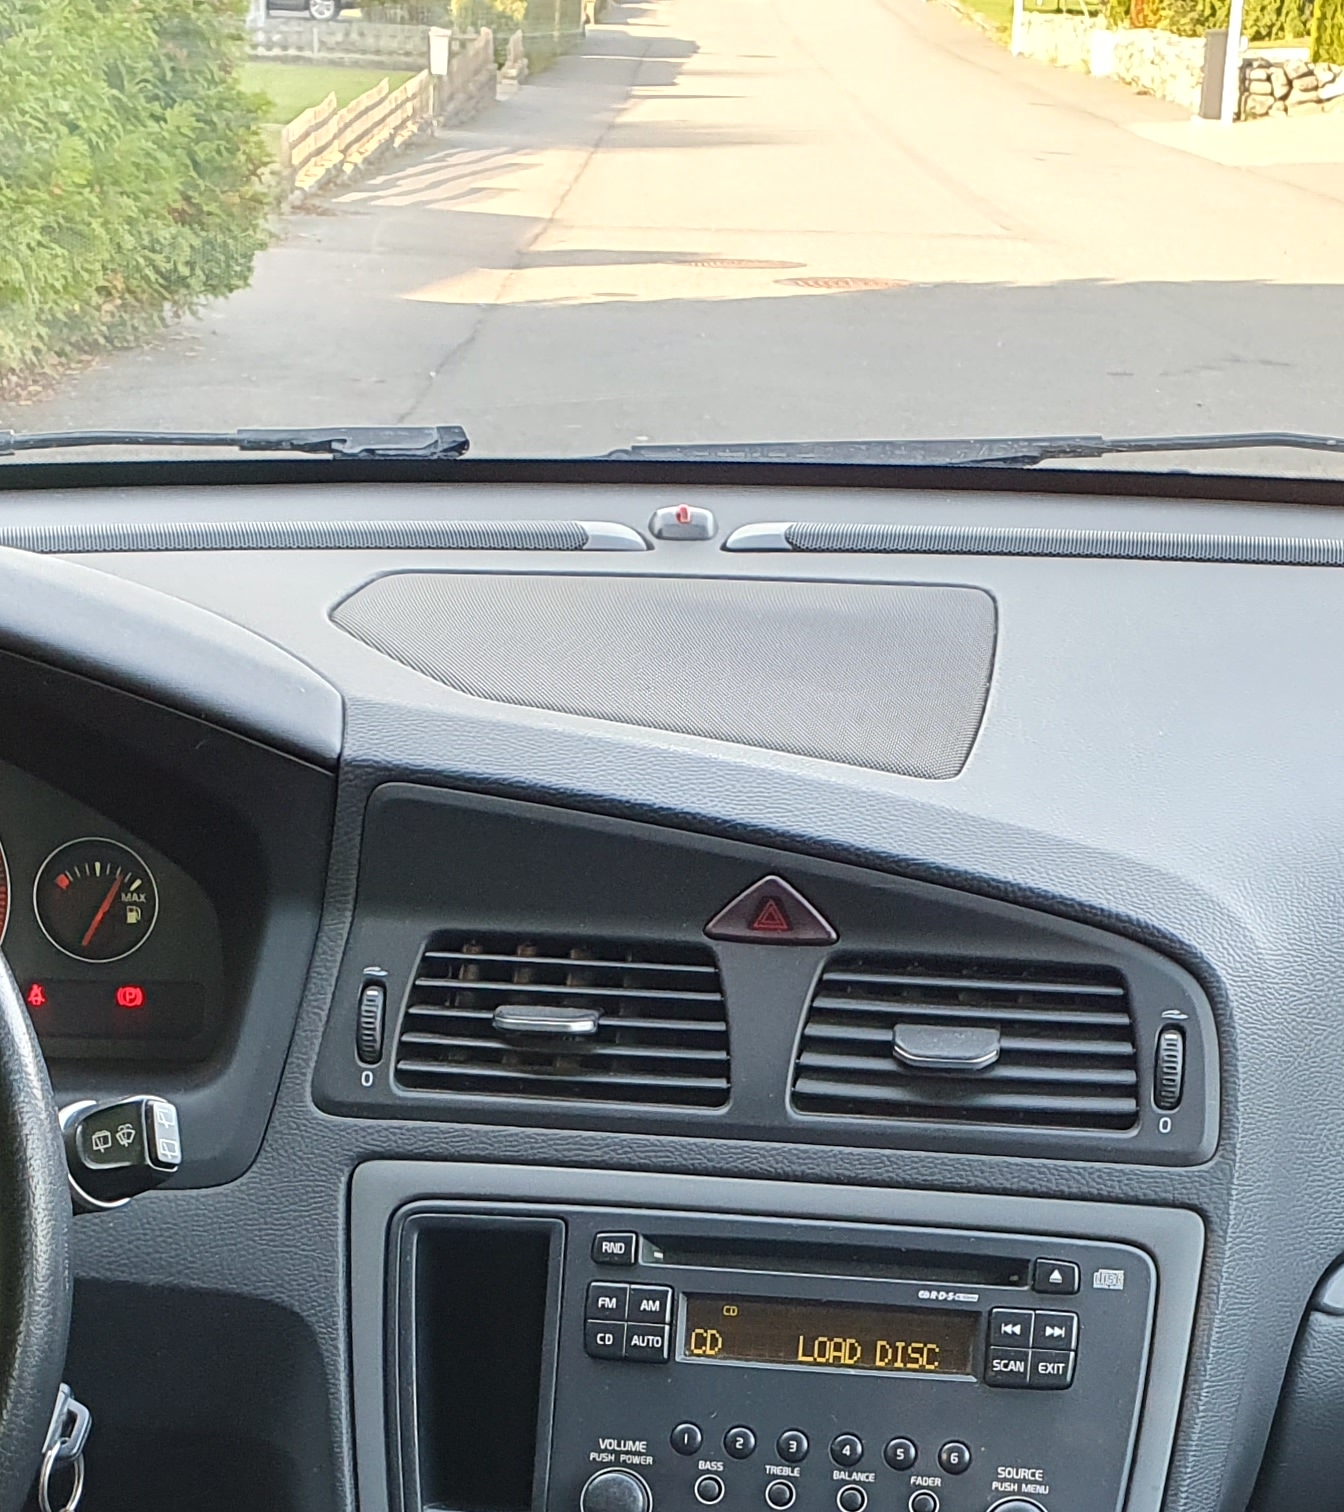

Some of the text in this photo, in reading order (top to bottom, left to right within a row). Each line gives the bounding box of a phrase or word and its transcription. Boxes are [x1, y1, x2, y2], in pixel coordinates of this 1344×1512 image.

[121, 893, 146, 903] MAX
[602, 1242, 625, 1254] RND
[598, 1297, 617, 1309] FM
[640, 1300, 660, 1311] AM
[723, 1305, 738, 1316] CD
[596, 1333, 613, 1345] CD
[631, 1335, 662, 1348] AUTO
[690, 1328, 723, 1355] CD
[797, 1335, 940, 1370] LOAD DISC
[992, 1360, 1025, 1373] SCAN
[1038, 1362, 1066, 1375] EXIT
[599, 1438, 647, 1452] VOLUME
[735, 1437, 744, 1449] 2
[789, 1441, 797, 1452] 3
[842, 1444, 851, 1456] 4
[896, 1449, 904, 1460] 5
[589, 1452, 654, 1465] PUSH POWER
[950, 1452, 959, 1464] 6
[698, 1460, 724, 1472] BASS
[765, 1464, 801, 1477] TREBLE
[833, 1470, 876, 1482] BALANCE
[997, 1466, 1044, 1481] SOURCE
[910, 1476, 942, 1487] FADER
[992, 1481, 1049, 1494] PUSH MENU
